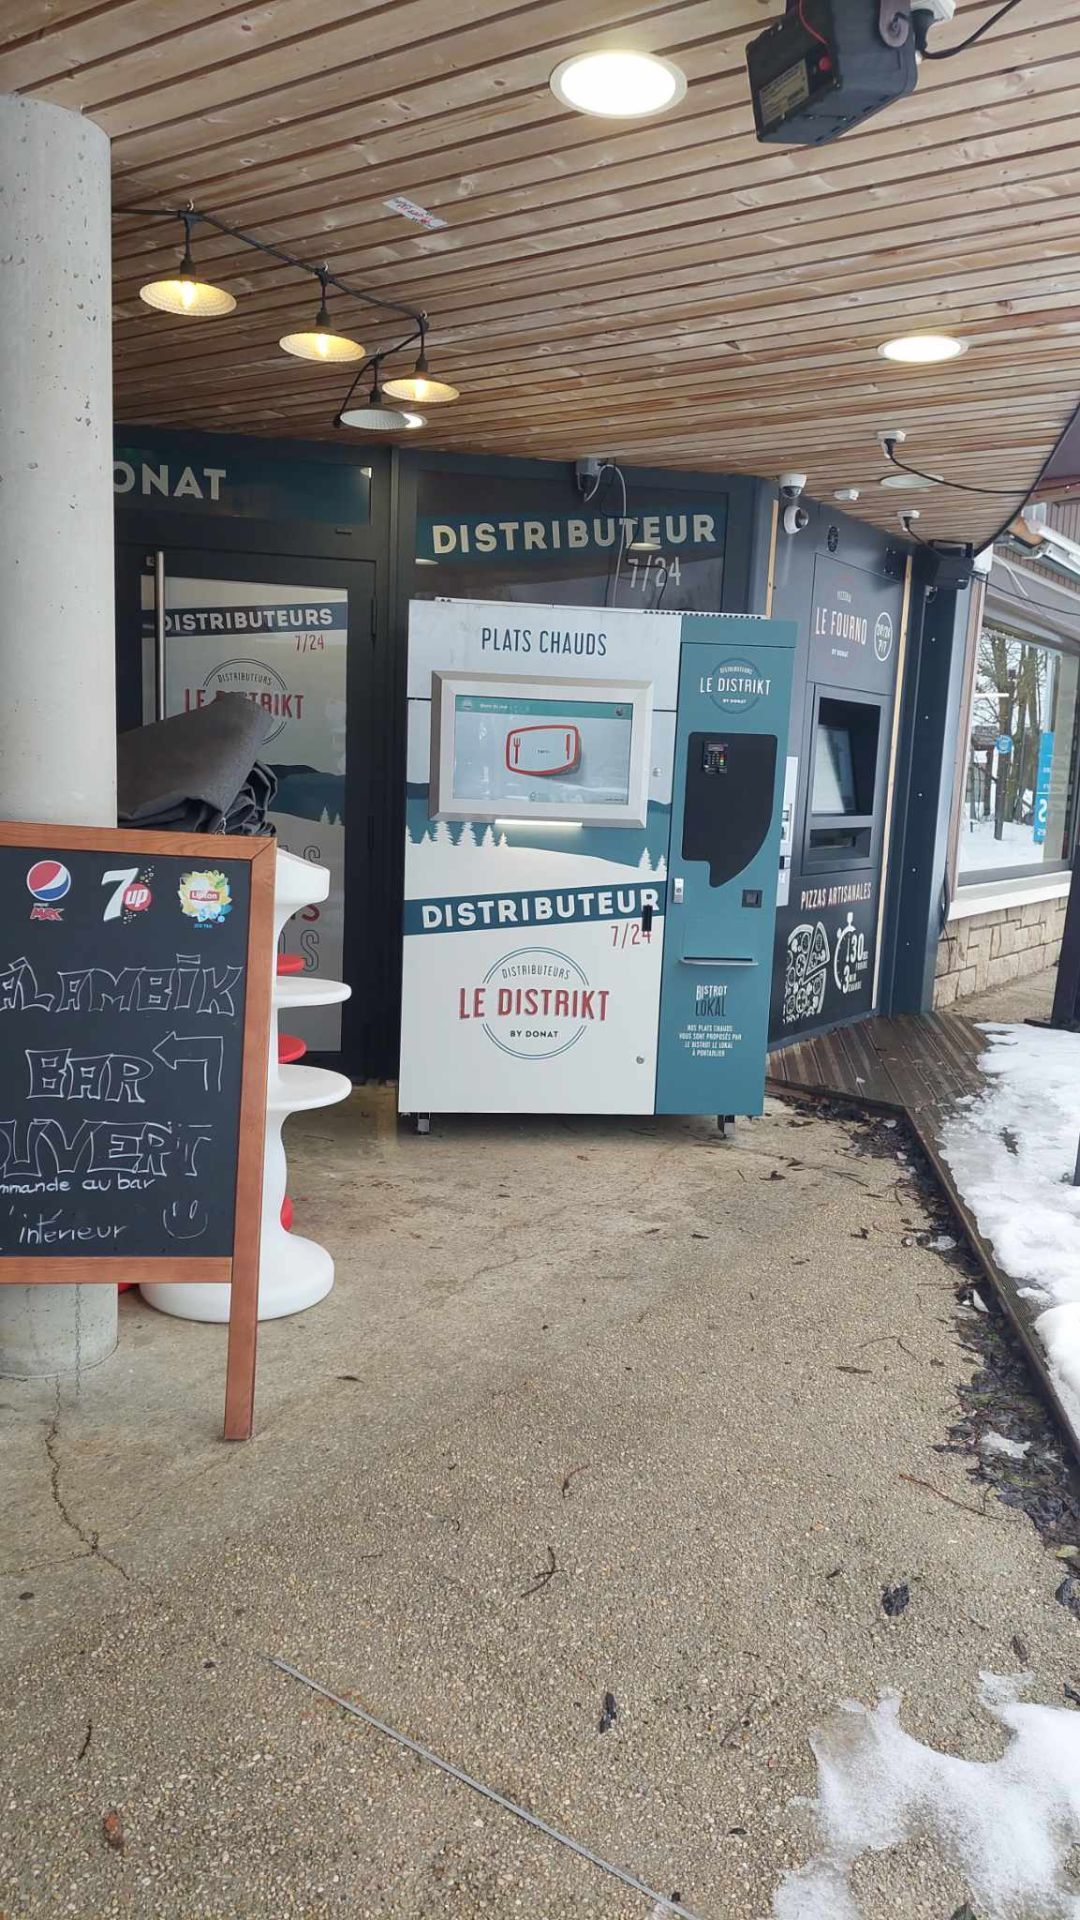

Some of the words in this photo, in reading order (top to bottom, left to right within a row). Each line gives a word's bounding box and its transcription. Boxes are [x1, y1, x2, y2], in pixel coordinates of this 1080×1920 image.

[432, 514, 717, 554] DISTRIBUTEUR
[628, 555, 682, 592] 7/24
[815, 607, 828, 635] LE
[830, 610, 868, 645] FOURNO
[295, 634, 325, 653] 7/24
[481, 627, 531, 652] PLATS
[539, 631, 607, 657] CHAUDS
[217, 672, 272, 686] DISTRIBUTEURS
[700, 677, 713, 693] LE
[717, 678, 771, 696] DISTRIKT
[421, 888, 660, 929] DISTRIBUTEUR
[800, 888, 827, 911] PIZZAS
[828, 882, 872, 906] ARTISANALES
[610, 923, 652, 949] 7/24
[850, 933, 864, 963] 30
[501, 964, 571, 980] DISTRIBUTEURS
[843, 964, 850, 994] 3
[459, 987, 486, 1020] LE
[497, 988, 610, 1021] DISTRIKT
[695, 985, 728, 1001] BISTROT
[695, 996, 726, 1017] LOKAL
[510, 1030, 522, 1038] BY
[525, 1030, 558, 1038] DONAT
[25, 1048, 154, 1103] BAR
[82, 1179, 111, 1191] au
[117, 1173, 156, 1190] bar
